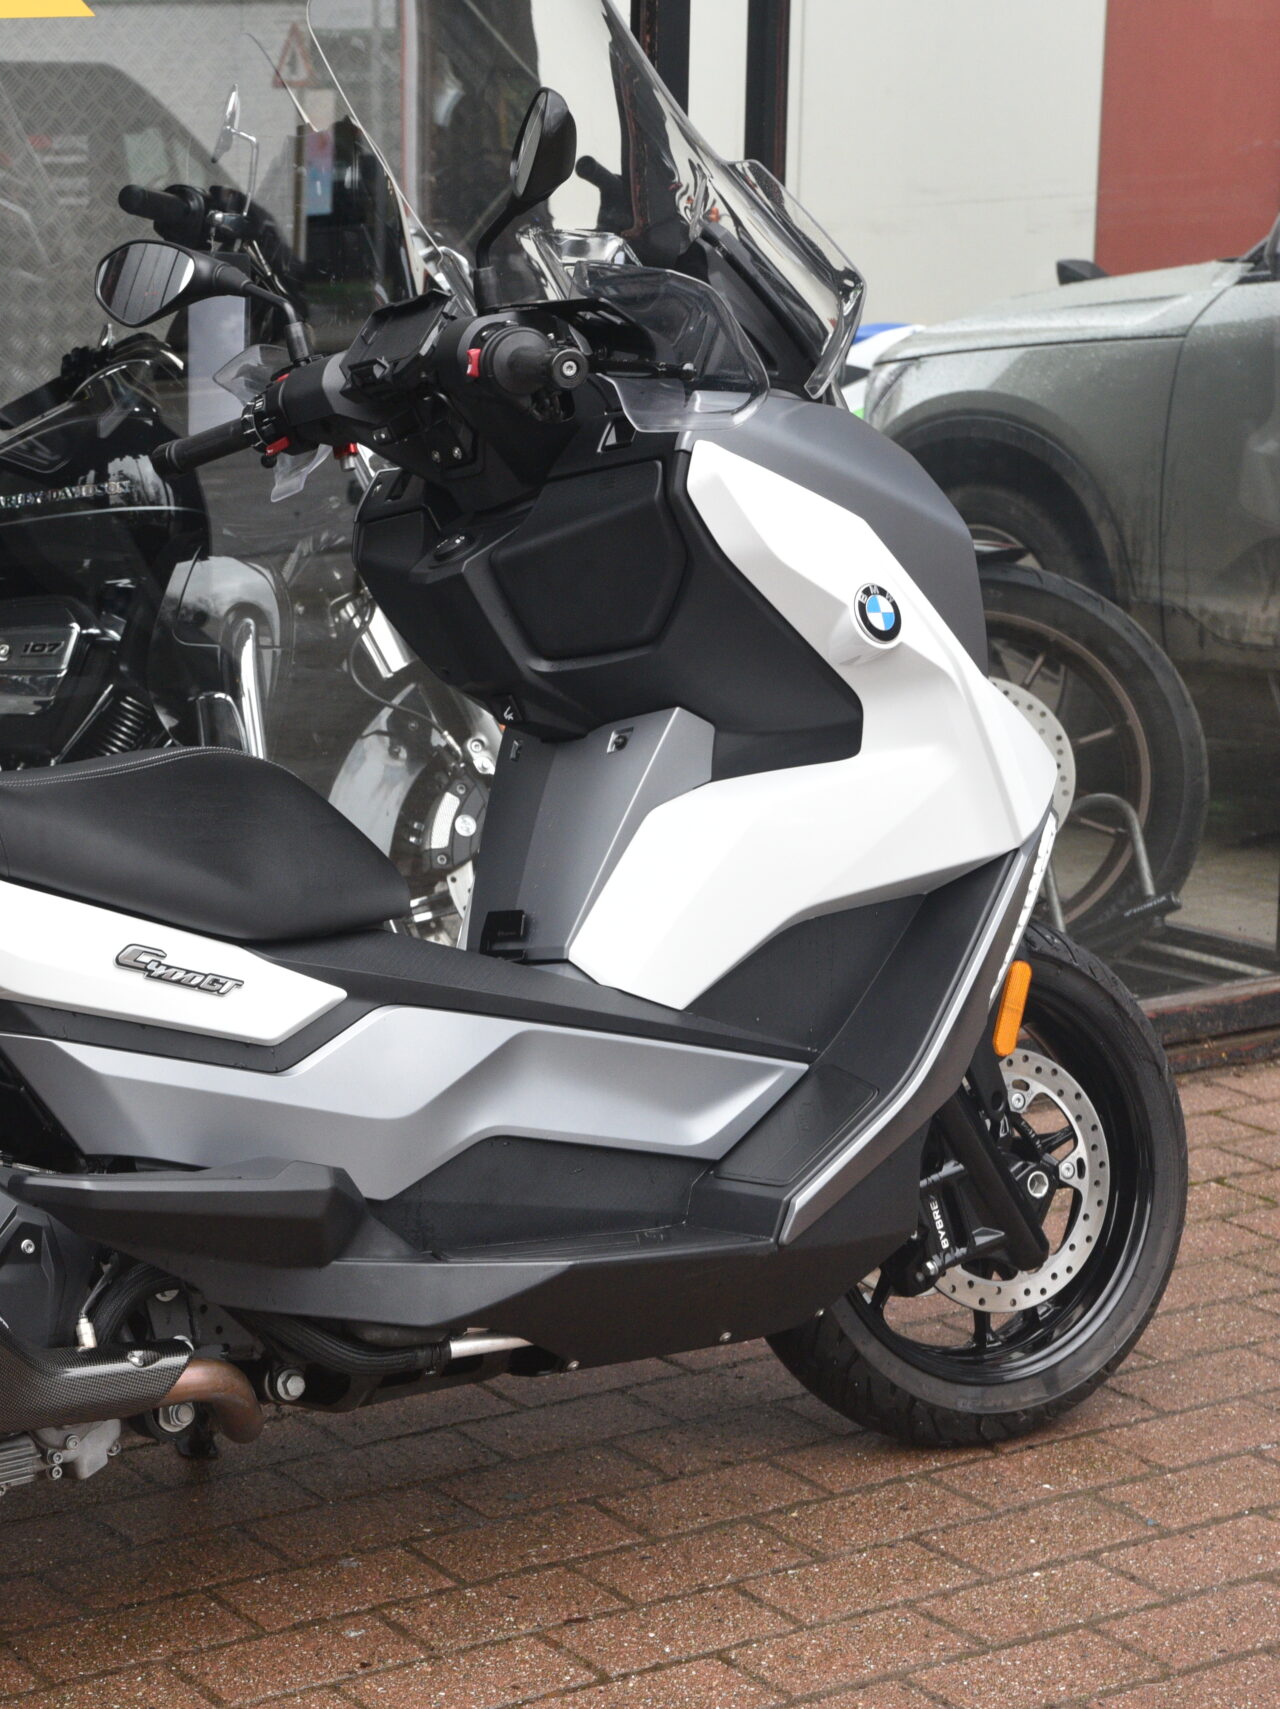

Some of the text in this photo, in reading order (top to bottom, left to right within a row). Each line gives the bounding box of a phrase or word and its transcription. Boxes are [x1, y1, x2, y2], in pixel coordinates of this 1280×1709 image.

[858, 584, 895, 604] BMW
[23, 641, 63, 655] 107
[930, 1200, 950, 1250] BYBRE
